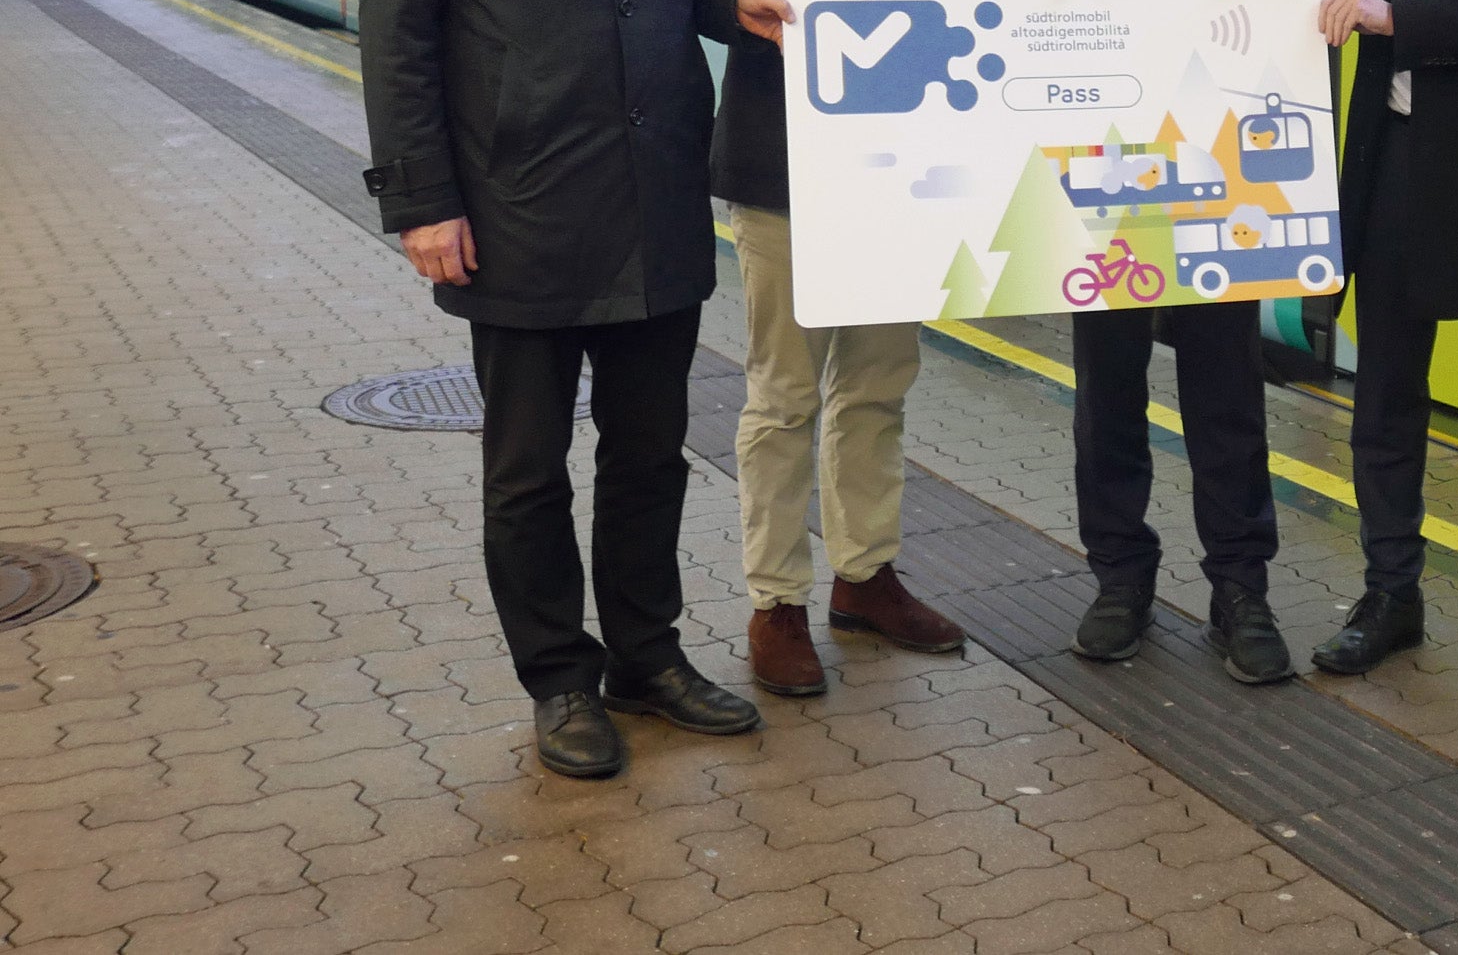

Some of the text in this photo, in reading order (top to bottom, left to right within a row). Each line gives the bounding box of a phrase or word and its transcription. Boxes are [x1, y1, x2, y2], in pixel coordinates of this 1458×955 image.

[1026, 11, 1111, 23] südtirolmobil
[1011, 24, 1130, 39] altoadigemobilità
[1047, 84, 1101, 104] Pass
